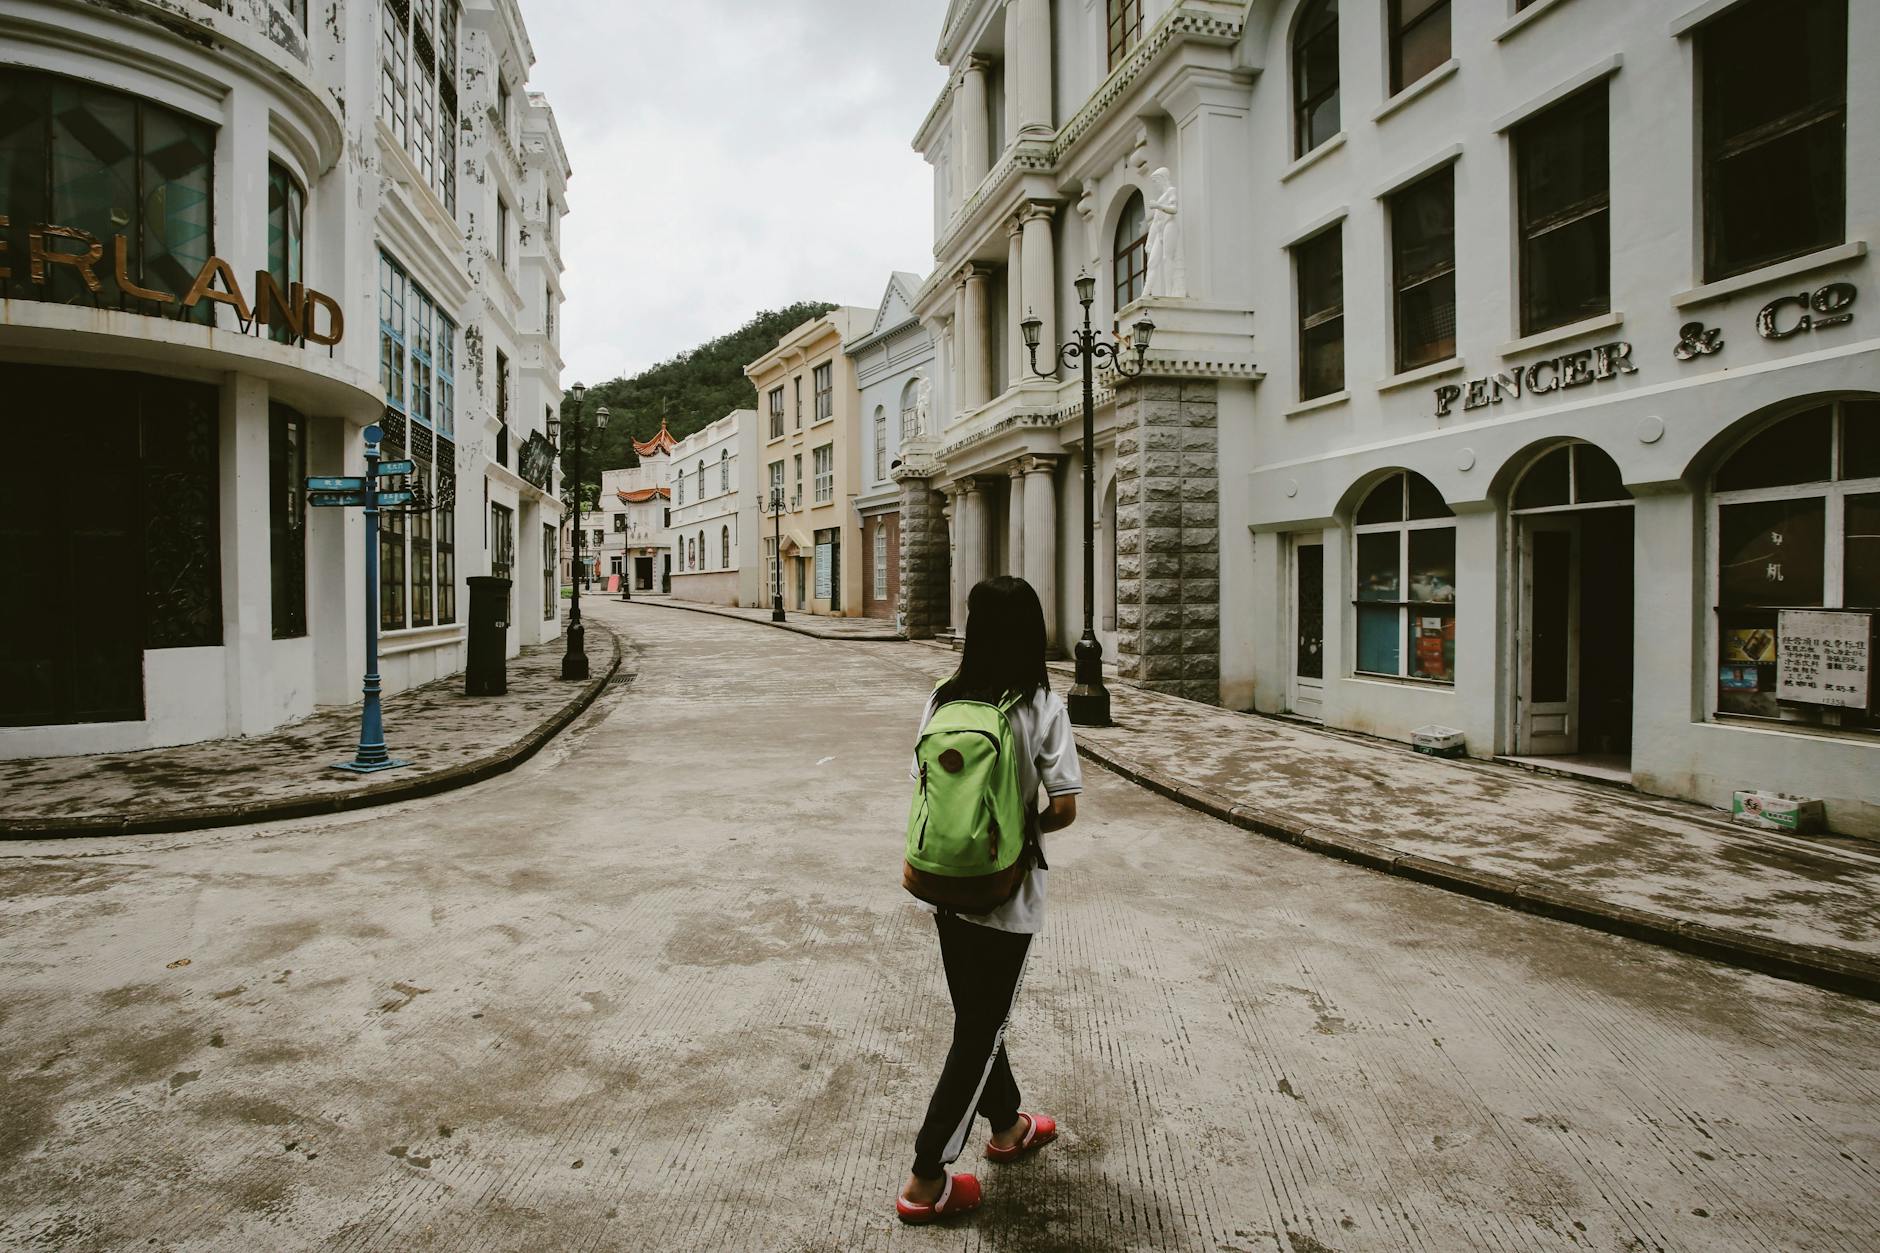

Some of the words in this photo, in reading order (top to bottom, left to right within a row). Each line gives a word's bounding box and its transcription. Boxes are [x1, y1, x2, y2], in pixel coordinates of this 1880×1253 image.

[0, 213, 344, 345] RLAND
[1434, 341, 1638, 417] PENCER
[1673, 321, 1724, 361] &
